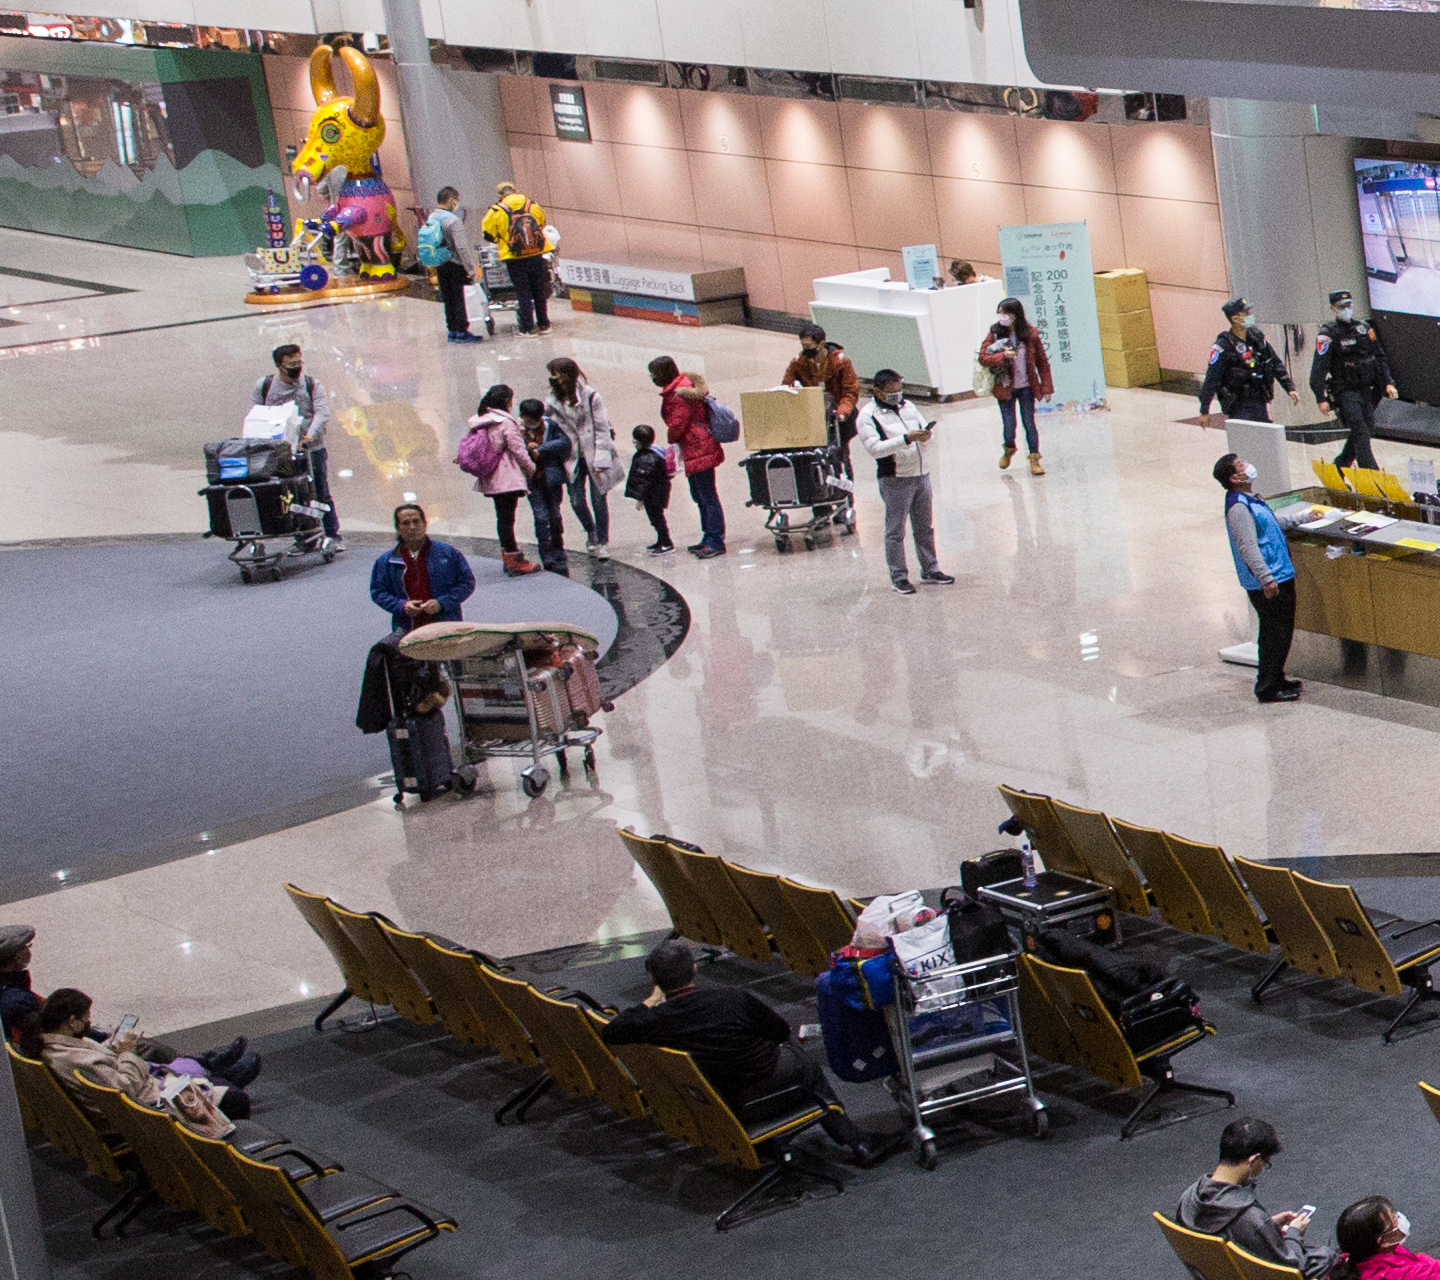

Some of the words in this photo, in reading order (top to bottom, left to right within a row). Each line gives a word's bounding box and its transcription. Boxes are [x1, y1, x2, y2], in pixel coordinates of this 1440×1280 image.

[613, 276, 640, 290] Luggage
[642, 278, 668, 294] Packing
[921, 952, 949, 972] KIX
